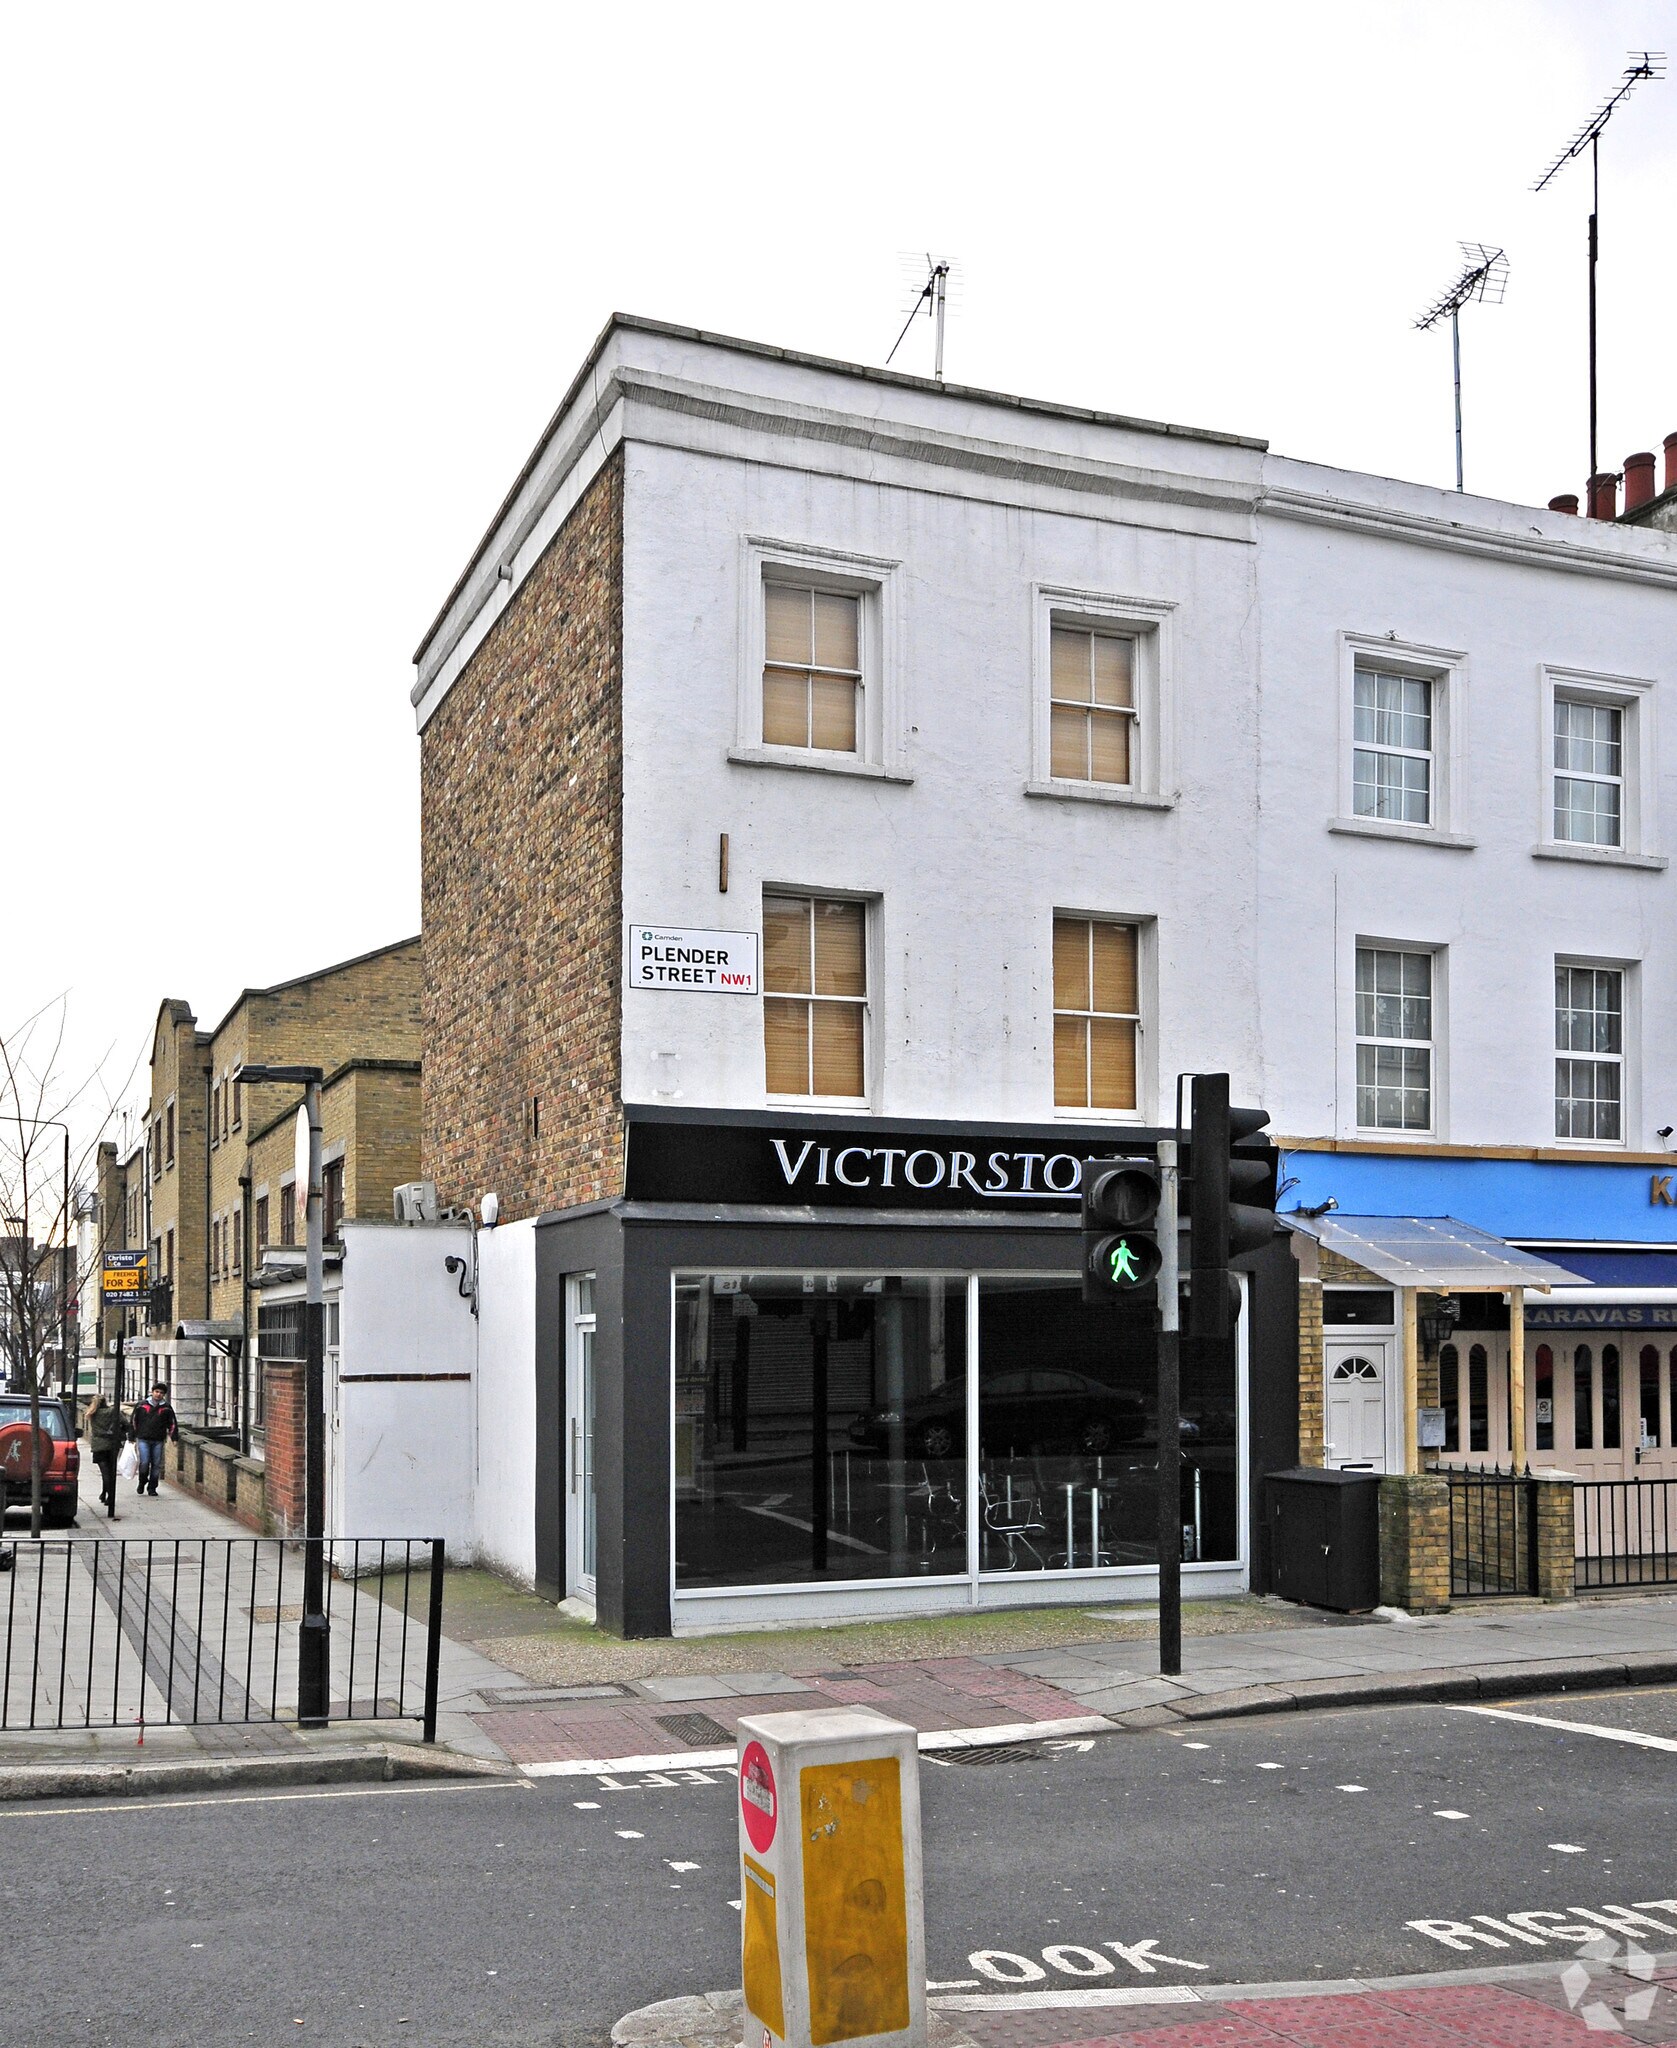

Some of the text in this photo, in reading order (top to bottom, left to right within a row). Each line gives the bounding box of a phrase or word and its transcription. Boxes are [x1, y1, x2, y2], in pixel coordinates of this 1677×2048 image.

[654, 933, 683, 942] Camden
[641, 946, 729, 965] PLENDER
[641, 965, 751, 986] STREET NW1
[769, 1139, 1150, 1199] VICTORSTO
[106, 1279, 139, 1287] FOR SA
